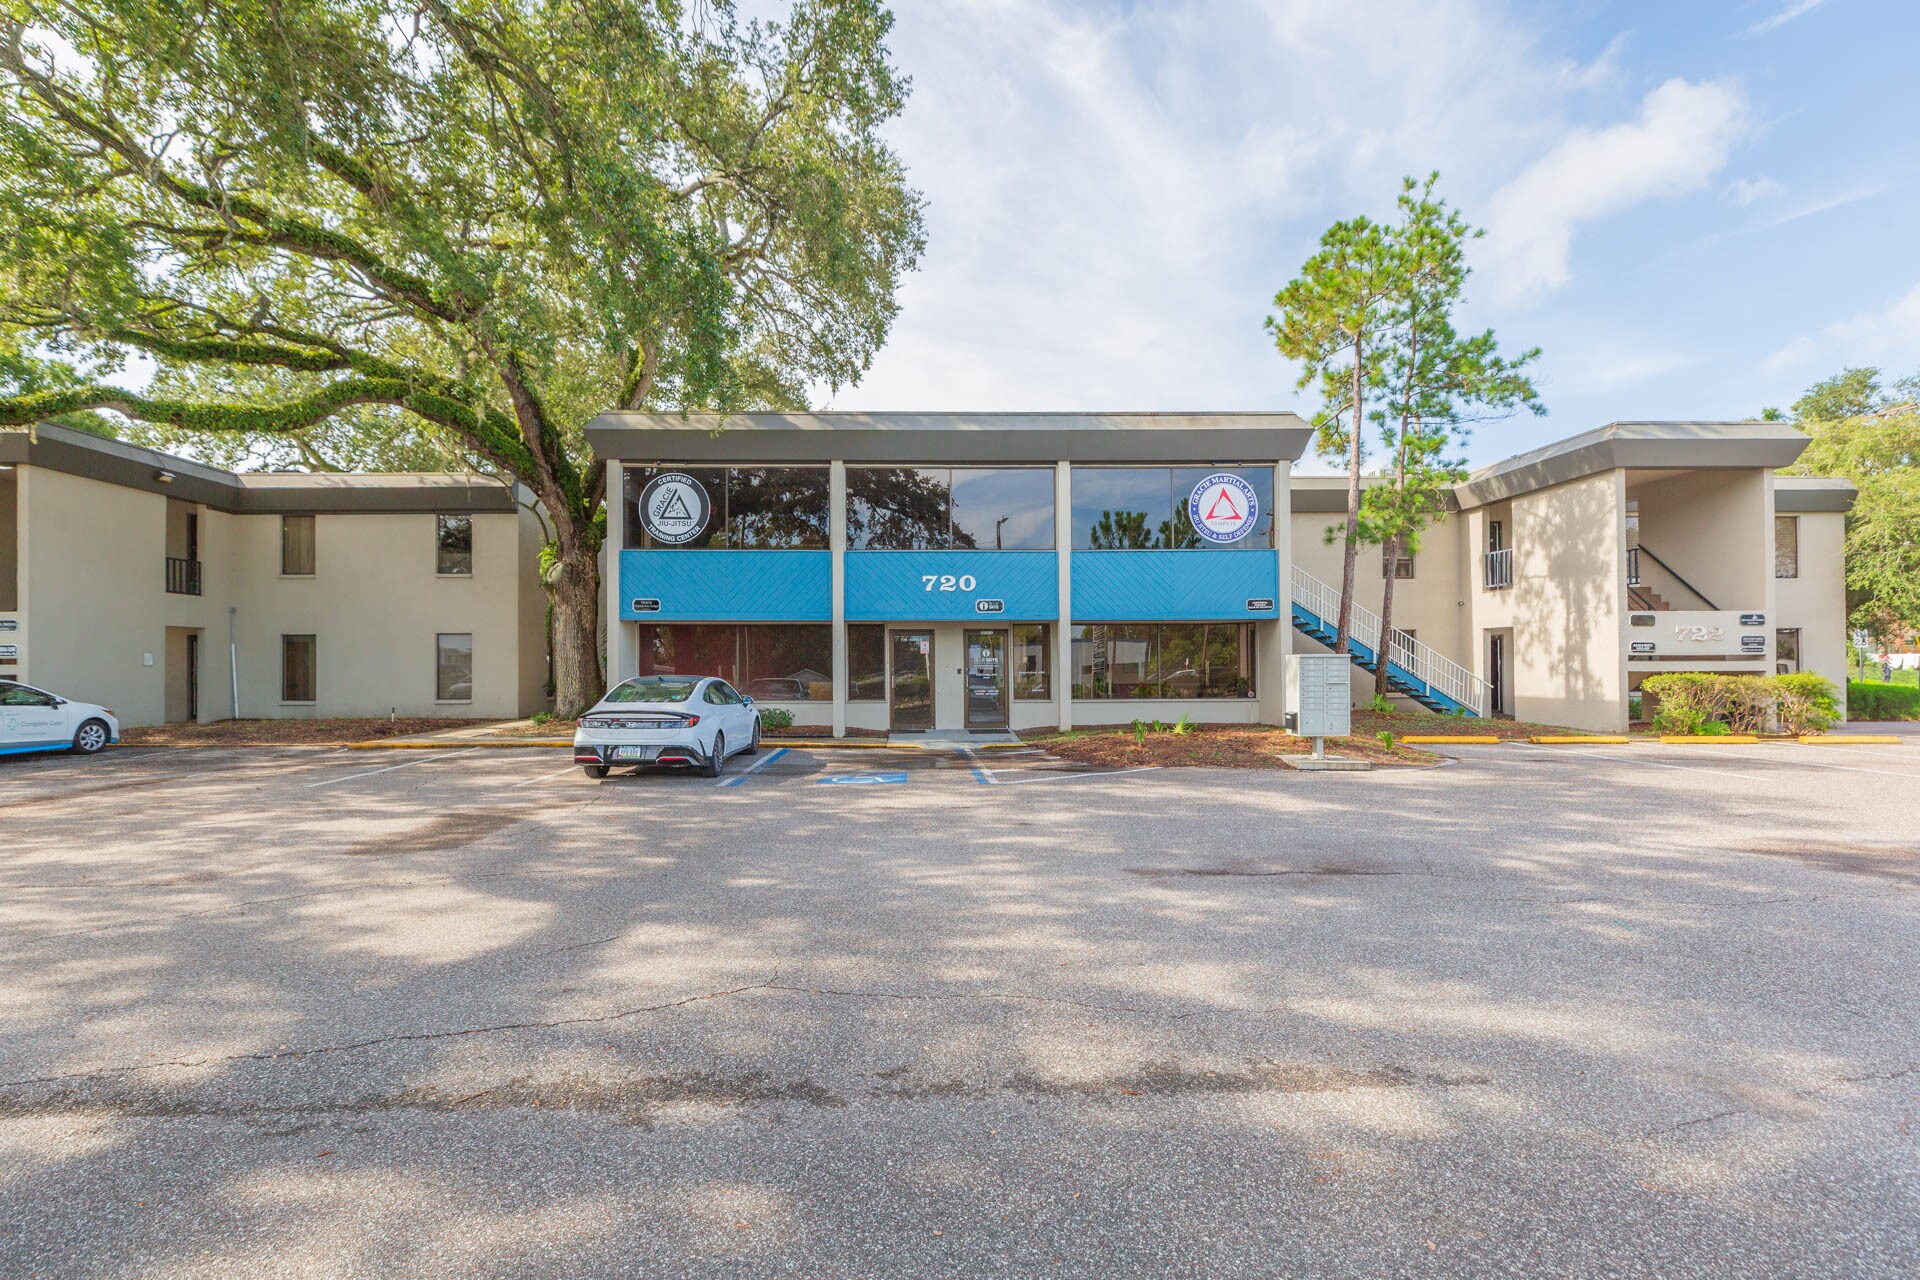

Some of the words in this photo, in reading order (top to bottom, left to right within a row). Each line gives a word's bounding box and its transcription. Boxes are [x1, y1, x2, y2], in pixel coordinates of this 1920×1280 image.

[657, 475, 692, 485] CERTIFIED
[1192, 480, 1212, 505] GRACIE
[1211, 476, 1244, 490] MARTIAL
[1242, 488, 1256, 506] ARTS
[652, 486, 674, 517] GRACIE
[647, 523, 675, 542] TRAINING
[676, 525, 701, 542] CENTER
[1233, 515, 1254, 538] DEFENSE
[922, 574, 977, 592] 720
[1675, 624, 1723, 641] 722
